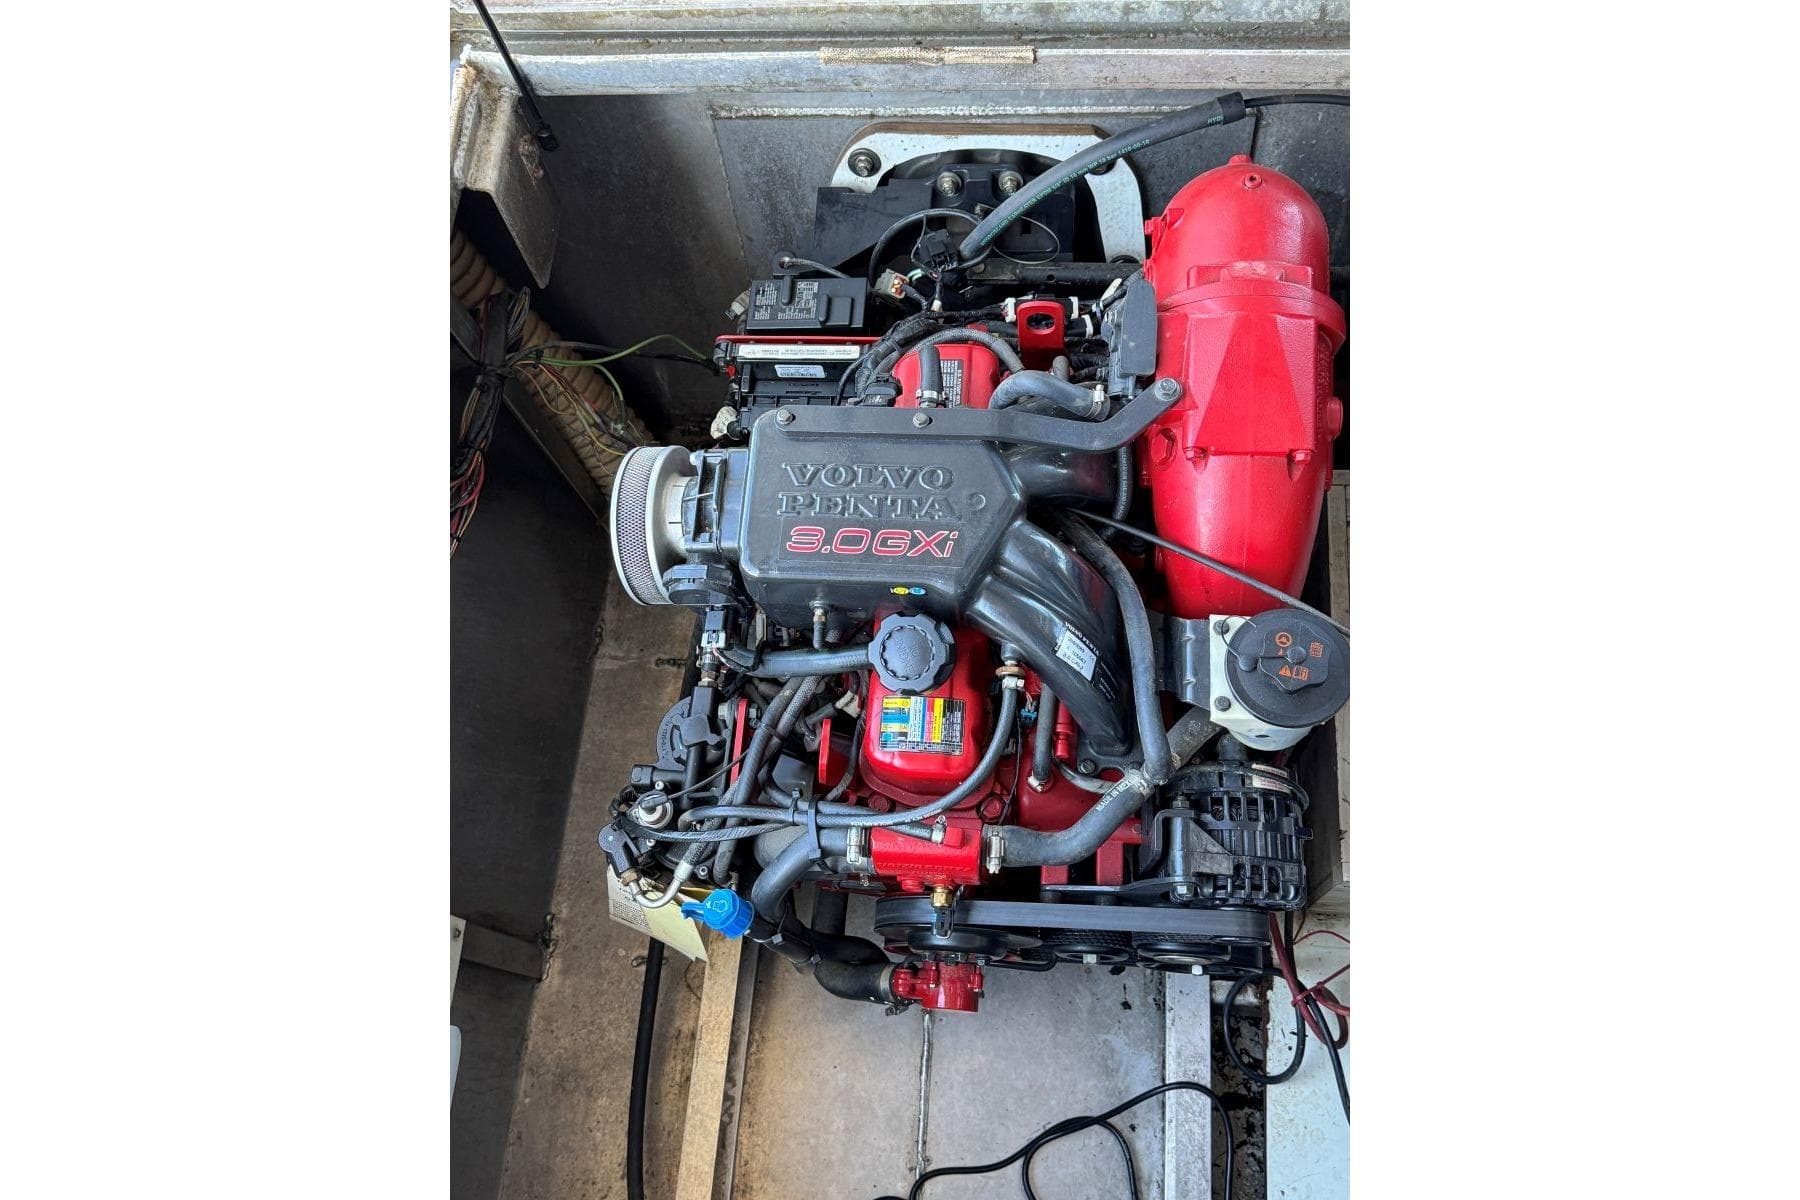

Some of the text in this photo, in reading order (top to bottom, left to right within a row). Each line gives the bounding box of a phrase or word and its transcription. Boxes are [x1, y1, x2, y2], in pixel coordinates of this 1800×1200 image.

[782, 463, 954, 491] VOLVO
[777, 491, 962, 520] PENTA
[786, 526, 959, 558] 3.0GXi
[1065, 621, 1083, 639] VOLVO
[1082, 636, 1099, 657] PENTA
[1095, 795, 1114, 811] MADE
[1110, 788, 1120, 798] IN
